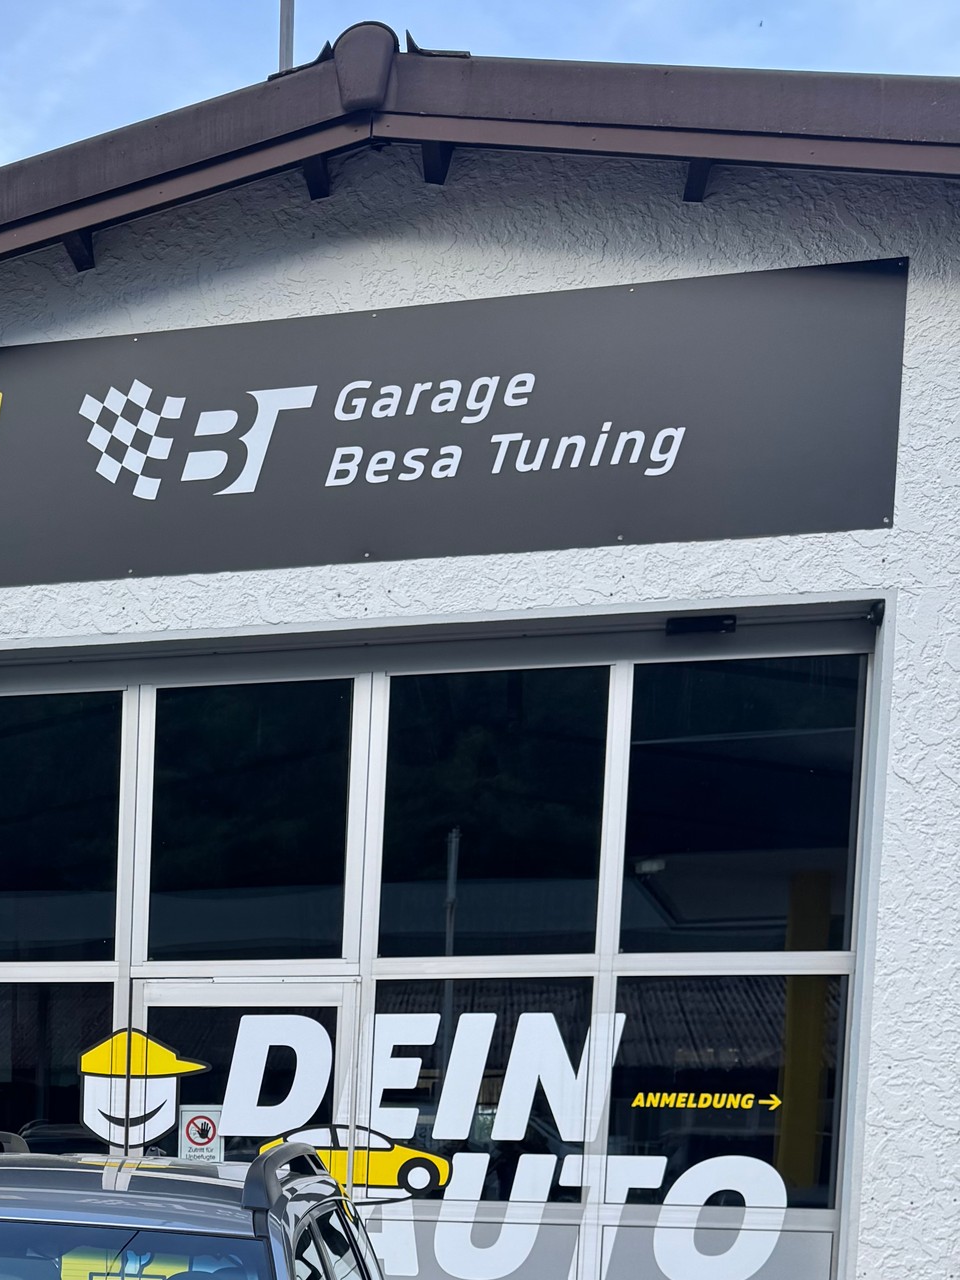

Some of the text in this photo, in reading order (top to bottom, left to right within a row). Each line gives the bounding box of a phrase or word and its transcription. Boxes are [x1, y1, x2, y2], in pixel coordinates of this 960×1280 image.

[333, 372, 536, 425] Garage
[324, 421, 687, 487] Besa Tuning
[218, 1012, 626, 1143] DEIN
[631, 1092, 756, 1109] ANMELDUNG
